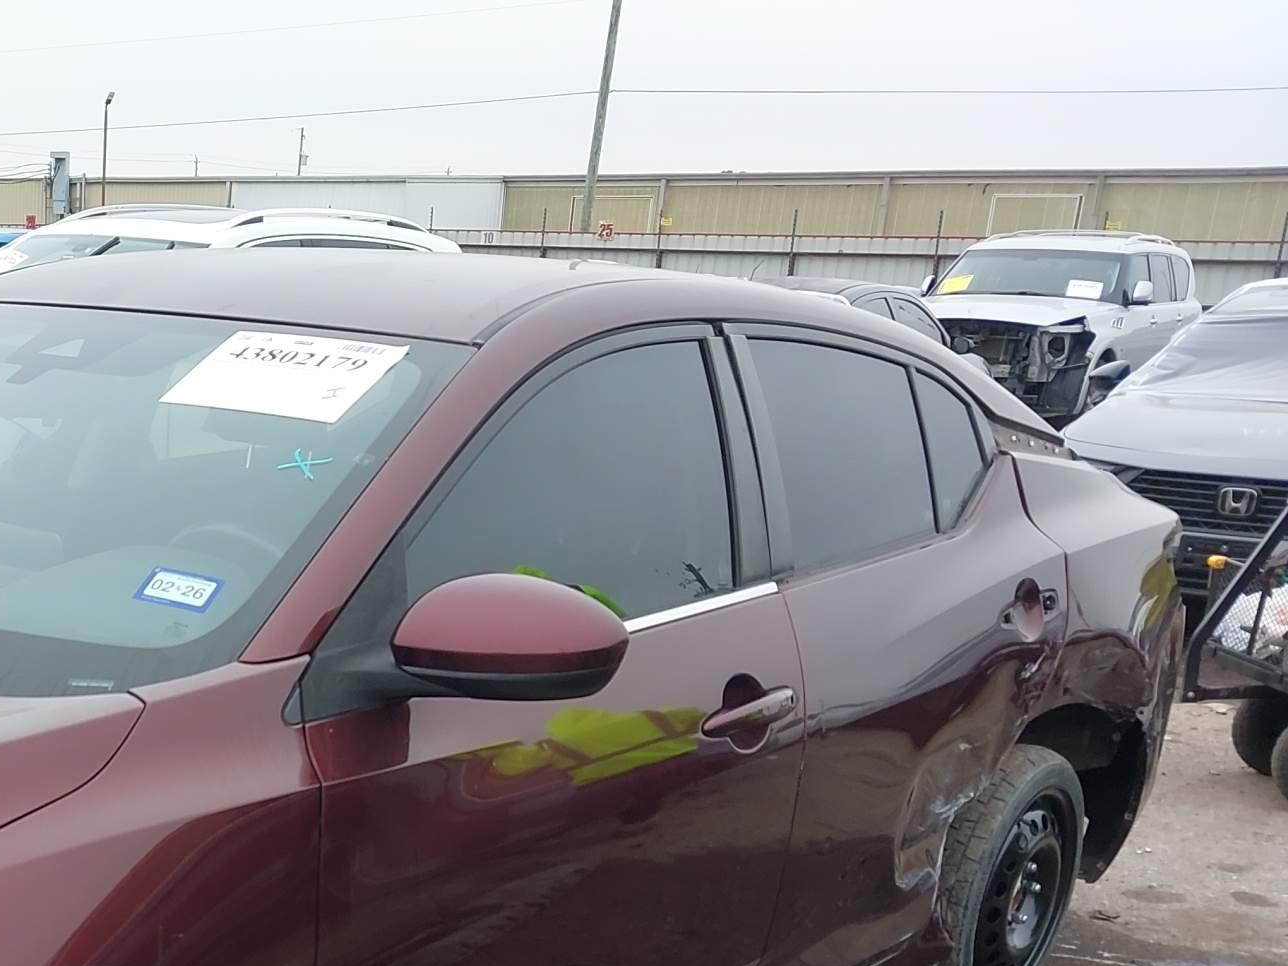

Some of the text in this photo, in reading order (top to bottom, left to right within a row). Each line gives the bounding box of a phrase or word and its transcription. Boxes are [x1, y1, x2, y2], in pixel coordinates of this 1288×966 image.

[598, 224, 613, 237] 25
[483, 232, 494, 244] 10
[229, 346, 369, 371] 43802179
